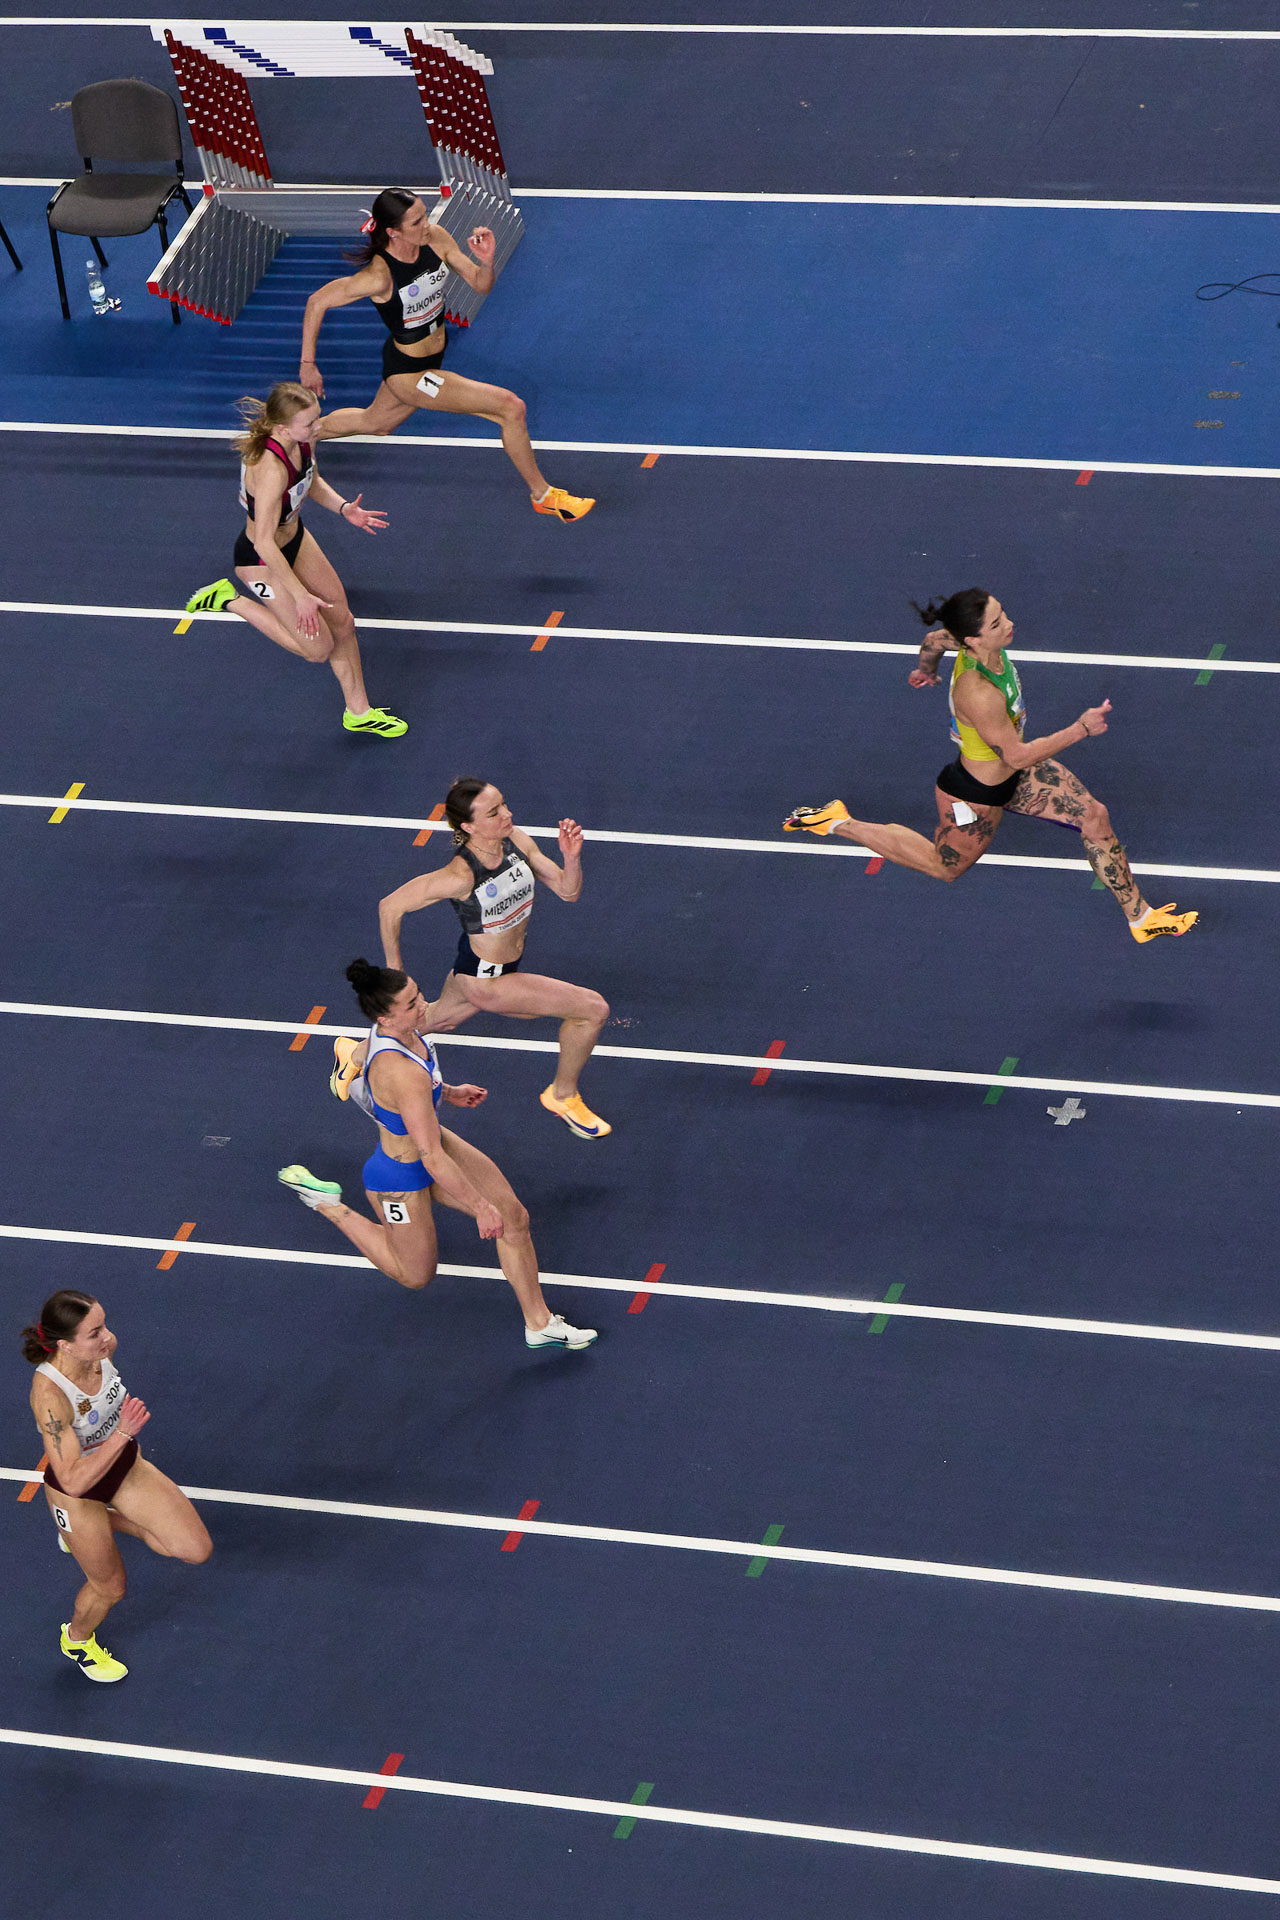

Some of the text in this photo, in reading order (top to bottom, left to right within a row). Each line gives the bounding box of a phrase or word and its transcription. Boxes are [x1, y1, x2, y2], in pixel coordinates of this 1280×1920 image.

[406, 288, 443, 315] ŻUKOWS
[423, 376, 440, 388] 1
[254, 582, 270, 598] 2
[508, 867, 523, 883] 14
[484, 883, 532, 918] MIERZYŃSKA
[1143, 925, 1179, 938] NITRO
[482, 965, 496, 977] 4
[389, 1204, 403, 1222] 5
[55, 1508, 66, 1529] 6
